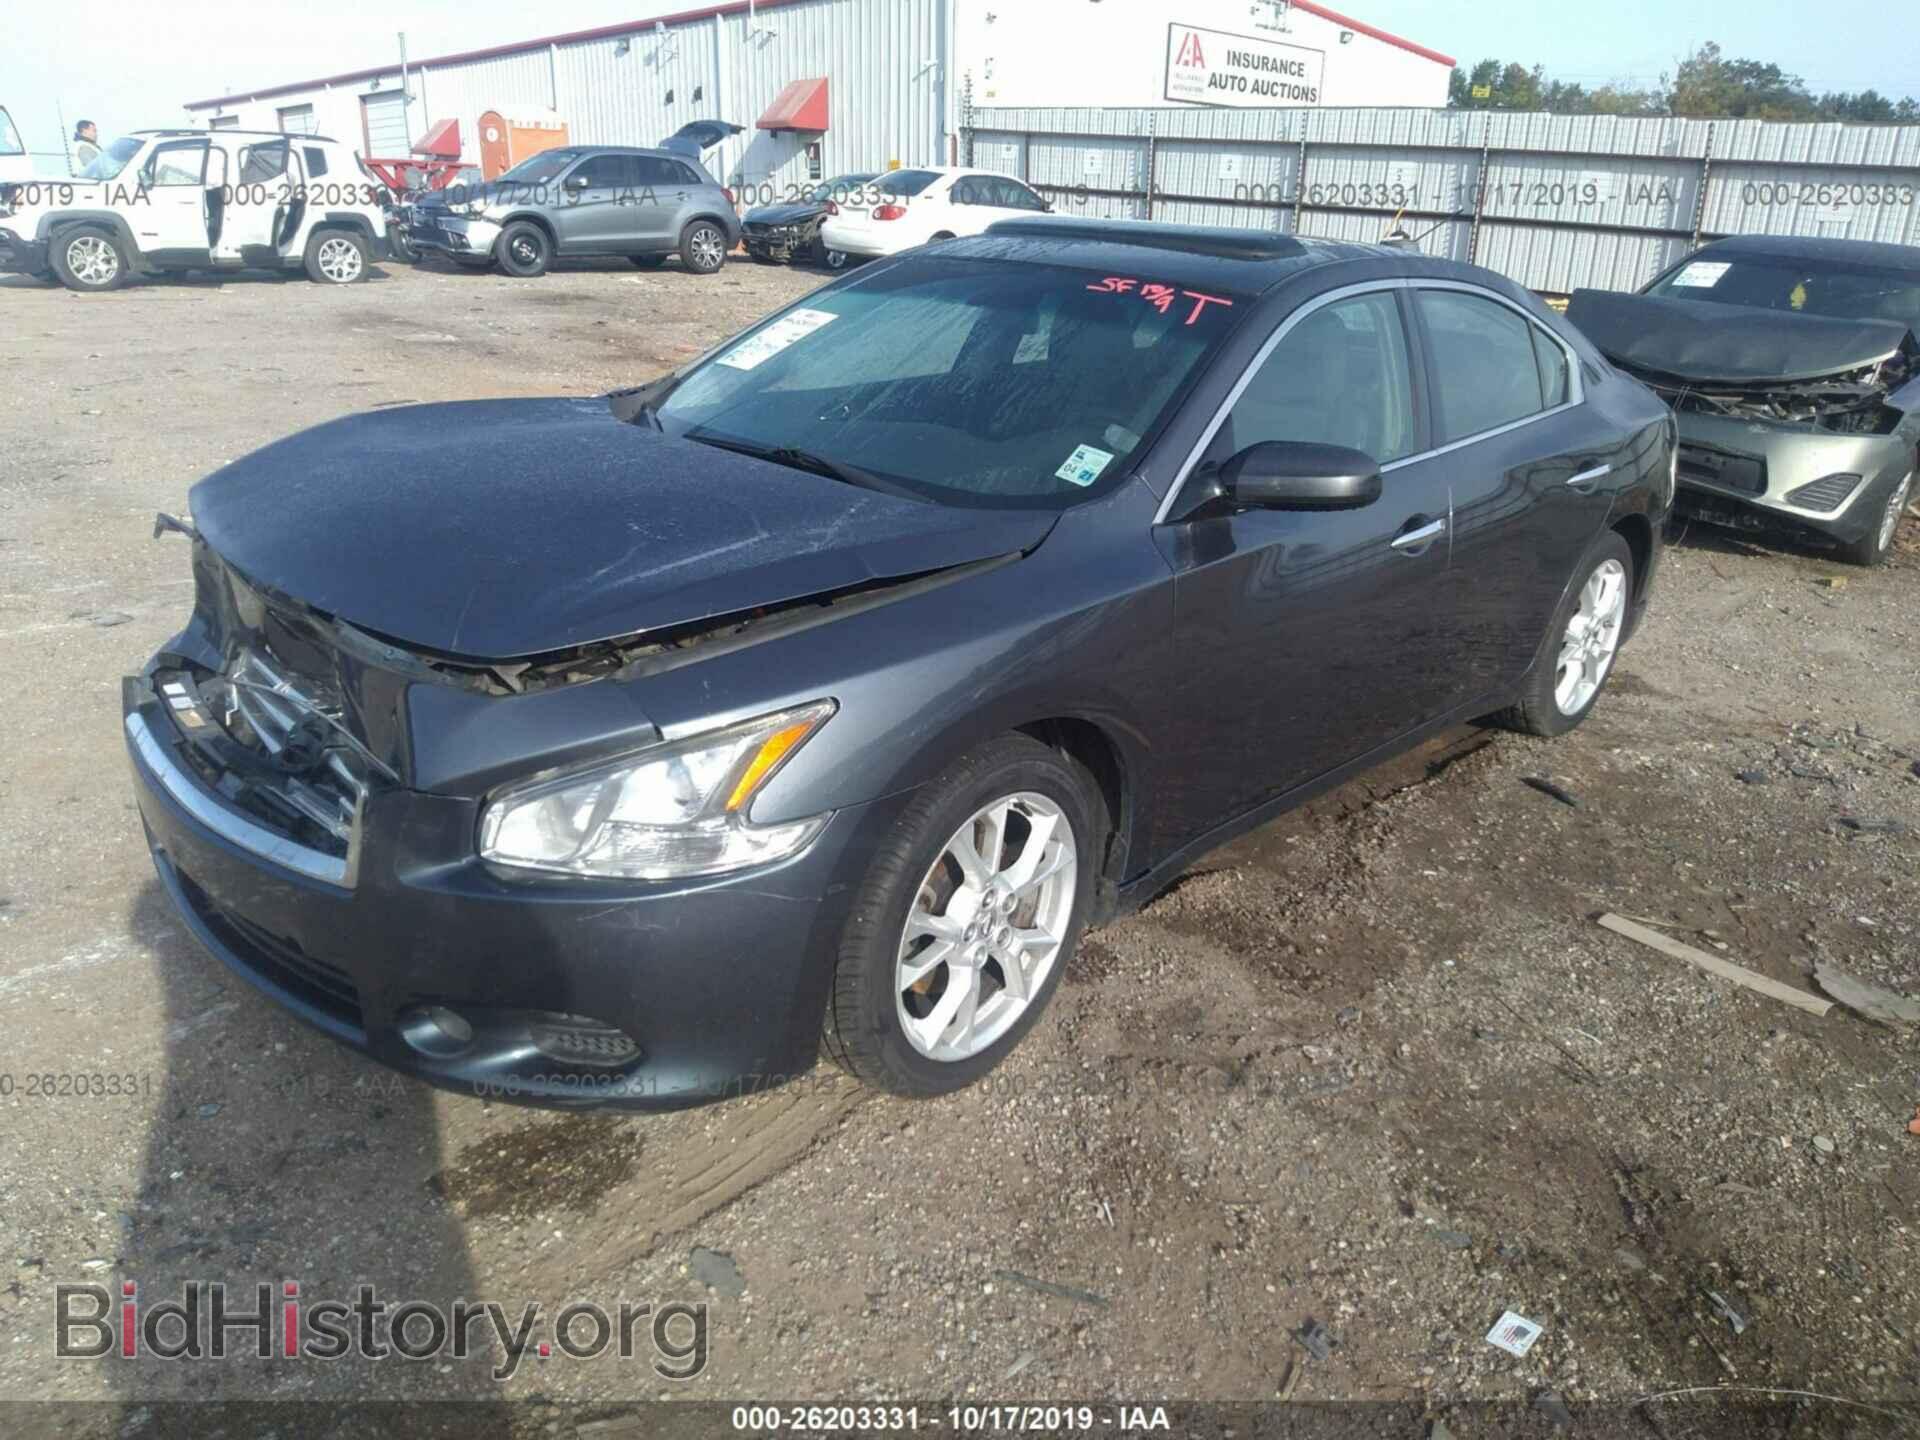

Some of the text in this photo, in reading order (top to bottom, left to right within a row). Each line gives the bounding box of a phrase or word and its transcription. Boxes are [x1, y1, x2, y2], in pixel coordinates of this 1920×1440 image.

[1227, 50, 1305, 78] INSURANCE
[1208, 71, 1247, 93] AUTO
[1250, 79, 1317, 103] AUCTIONS
